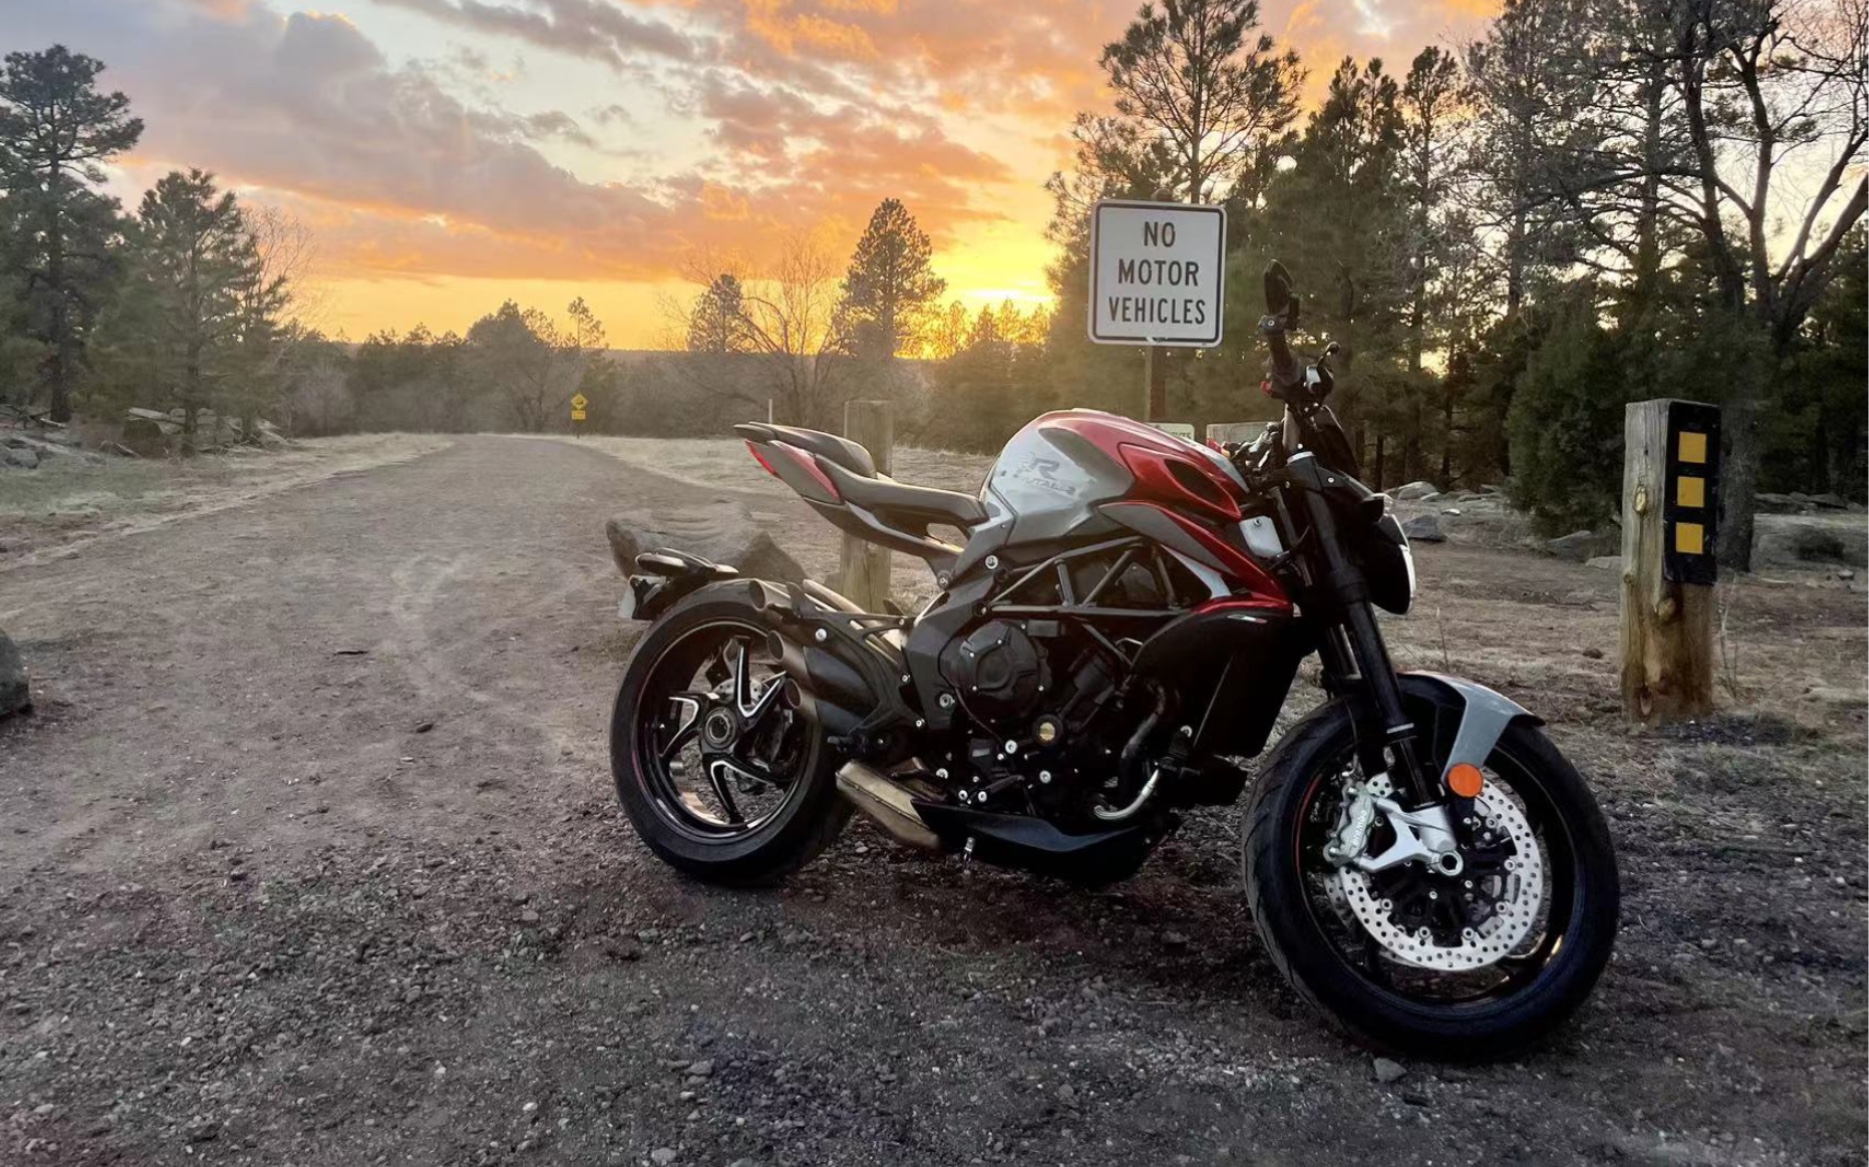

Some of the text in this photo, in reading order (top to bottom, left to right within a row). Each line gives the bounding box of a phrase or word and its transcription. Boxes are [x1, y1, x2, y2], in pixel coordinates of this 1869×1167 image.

[1144, 221, 1176, 248] NO
[1118, 258, 1199, 286] MOTOR
[1109, 296, 1206, 325] VEHICLES
